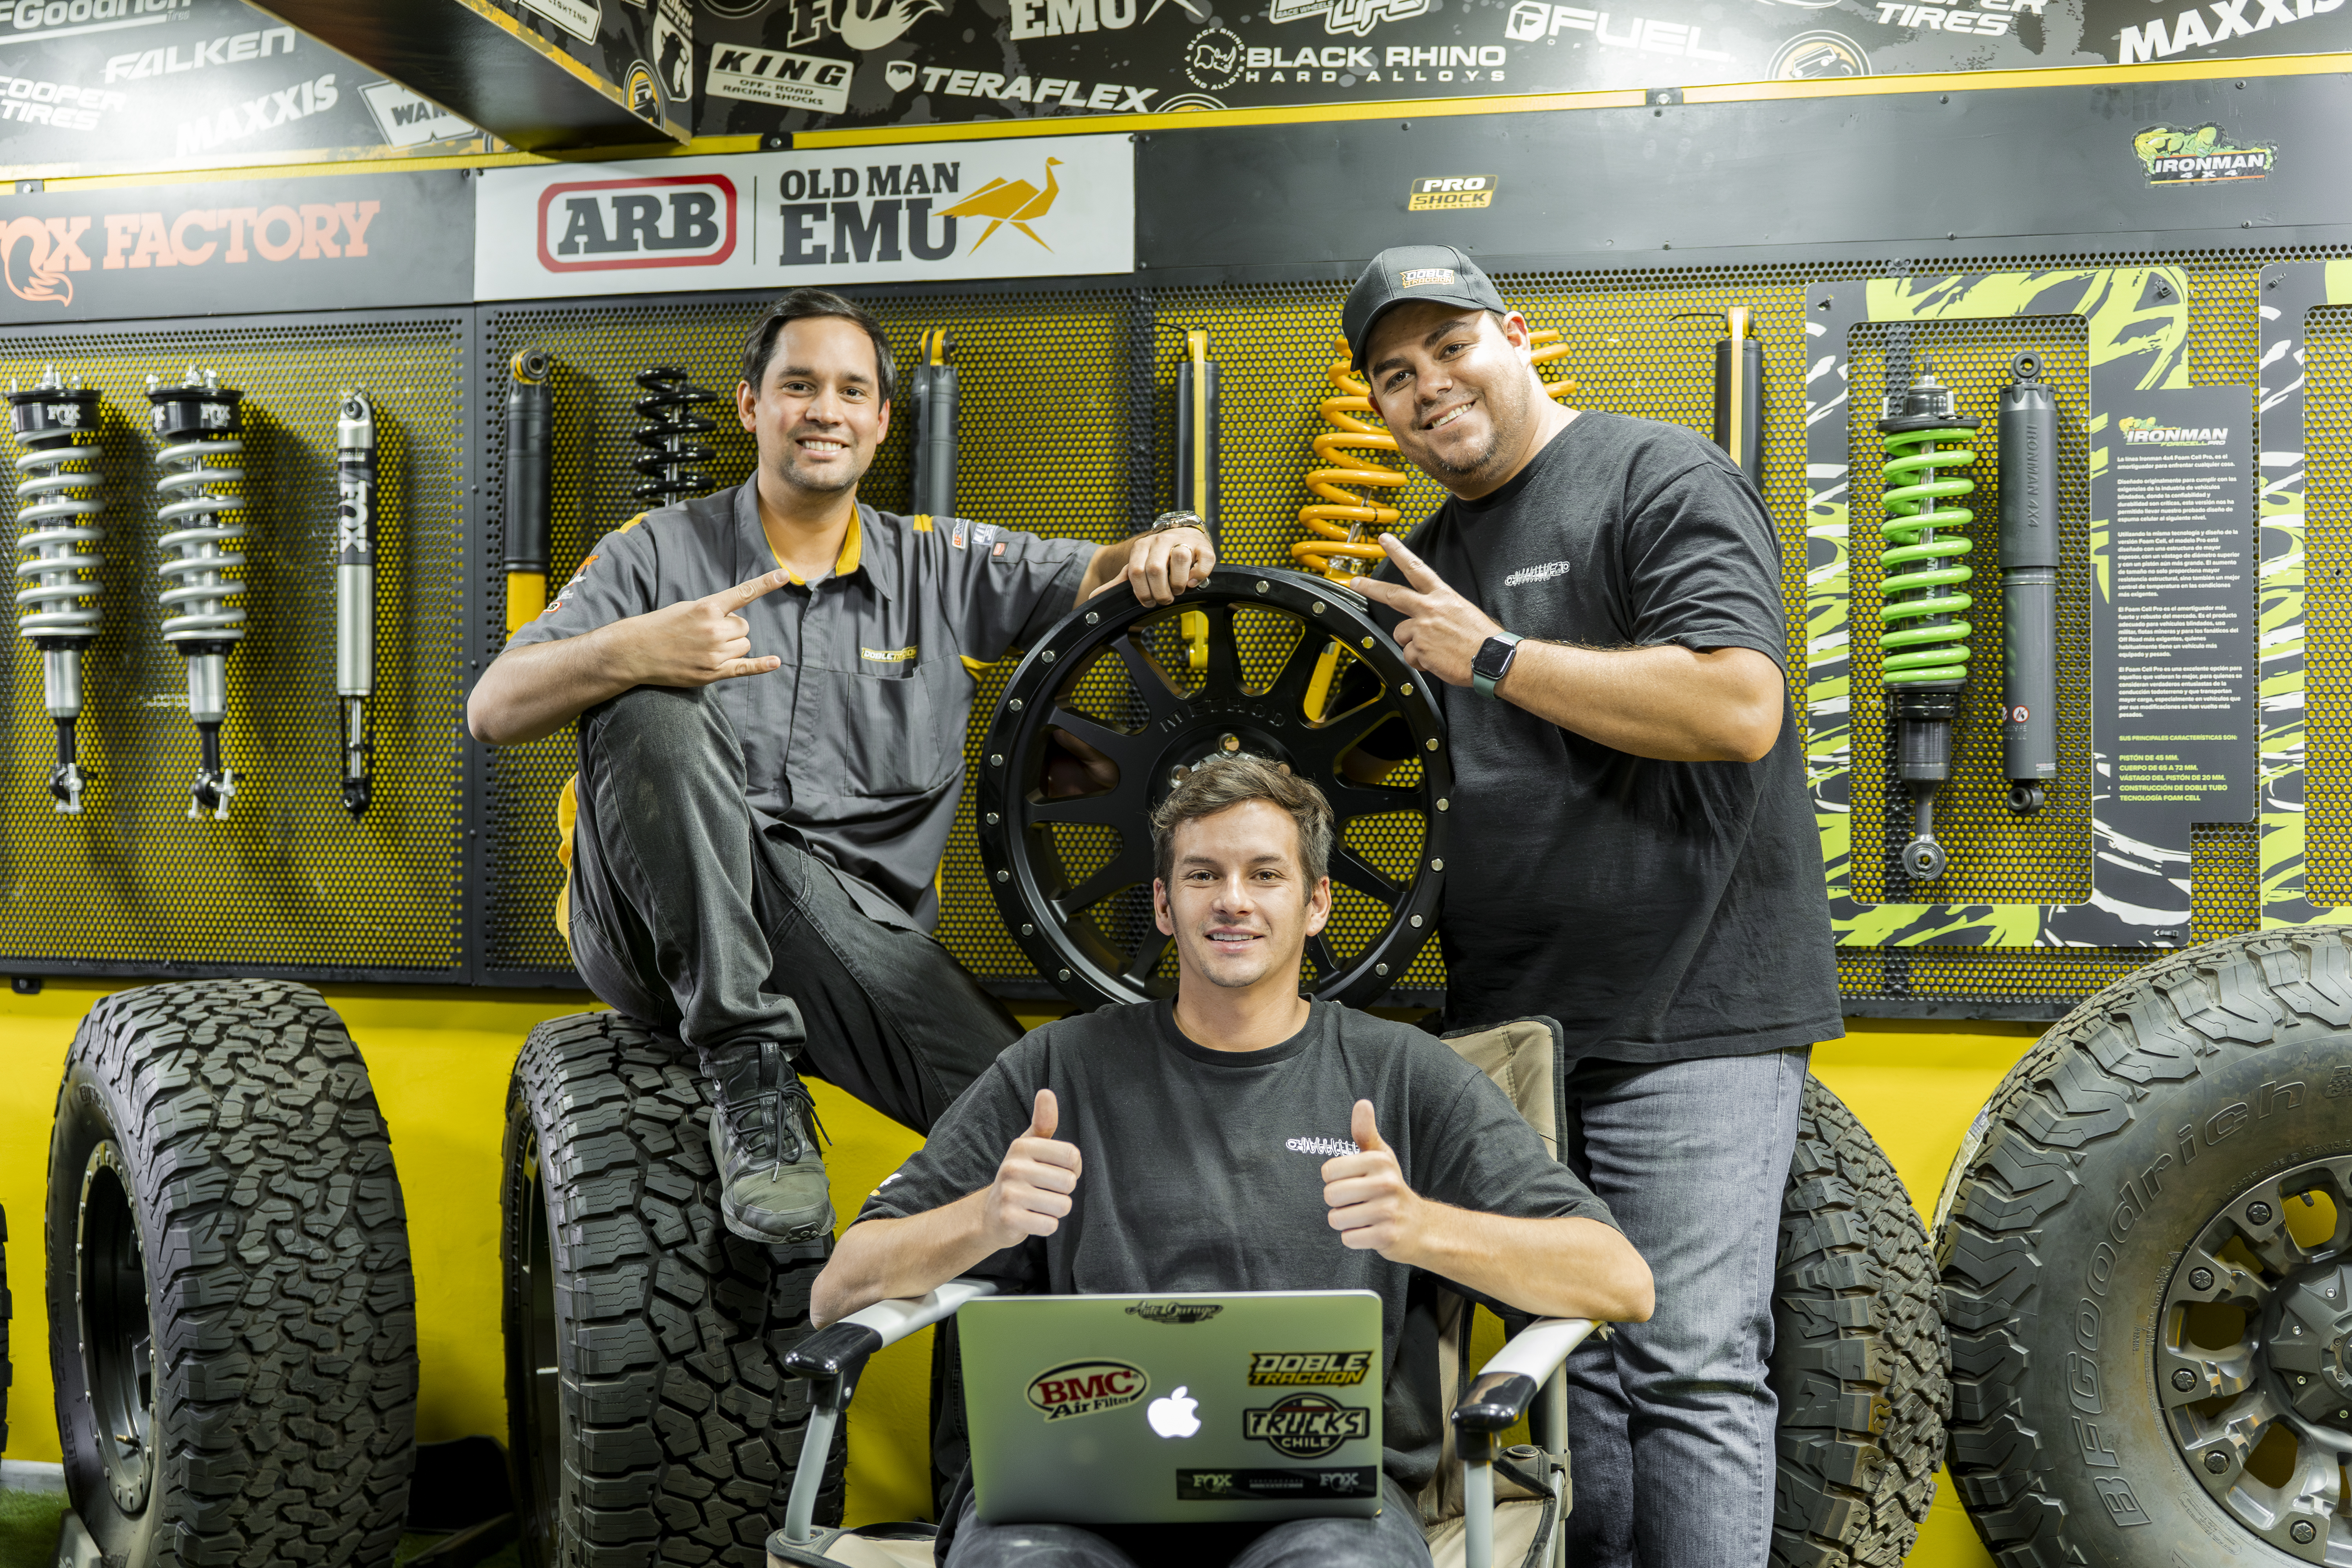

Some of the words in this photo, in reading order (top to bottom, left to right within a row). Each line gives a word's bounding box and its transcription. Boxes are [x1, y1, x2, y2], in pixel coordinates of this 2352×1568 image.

[1010, 0, 1137, 41] EMU
[1276, 8, 1299, 18] RACE
[1300, 0, 1334, 14] WHEELS
[1876, 2, 2014, 37] TIRES
[1187, 28, 1216, 51] BLACK
[1220, 28, 1245, 51] RHINO
[1548, 5, 1730, 63] FUEL
[99, 26, 295, 83] FALKEN
[1246, 46, 1373, 68] BLACK
[1385, 45, 1507, 67] RHINO
[715, 50, 847, 87] KING
[1245, 70, 1337, 82] HARD
[1366, 70, 1506, 82] ALLOYS
[723, 85, 771, 98] RACING
[775, 92, 824, 105] SHOCKS
[922, 66, 1159, 113] TERAFLEX
[1, 99, 101, 131] TIRES
[175, 73, 339, 157] MAXXIS
[2156, 153, 2265, 173] IRONMAN
[780, 167, 859, 201] OLD
[866, 161, 960, 197] MAN
[1422, 177, 1486, 193] PRO
[1414, 193, 1487, 205] SHOCK
[558, 192, 719, 255] ARB
[779, 198, 957, 267] EMU
[0, 216, 91, 307] OX
[102, 201, 381, 271] FACTORY
[1406, 269, 1452, 281] DOBLE
[47, 404, 81, 428] FOX
[200, 403, 231, 428] FOX
[2127, 428, 2228, 443] IRONMAN
[2027, 425, 2038, 496] IRONMAN
[337, 480, 368, 553] FOX
[2027, 499, 2040, 528] 4X4
[864, 650, 894, 661] DOBLE
[1159, 698, 1287, 733] METHOD
[1255, 1354, 1369, 1372] DOBLE
[1037, 1370, 1135, 1405] BMC
[1253, 1367, 1366, 1384] TRACCION
[1049, 1402, 1091, 1420] Air
[1093, 1396, 1129, 1410] Filter
[1251, 1411, 1362, 1435] TRUCKS
[1281, 1437, 1331, 1448] CHILE
[1193, 1474, 1233, 1494] FOX
[1319, 1472, 1359, 1492] FOX
